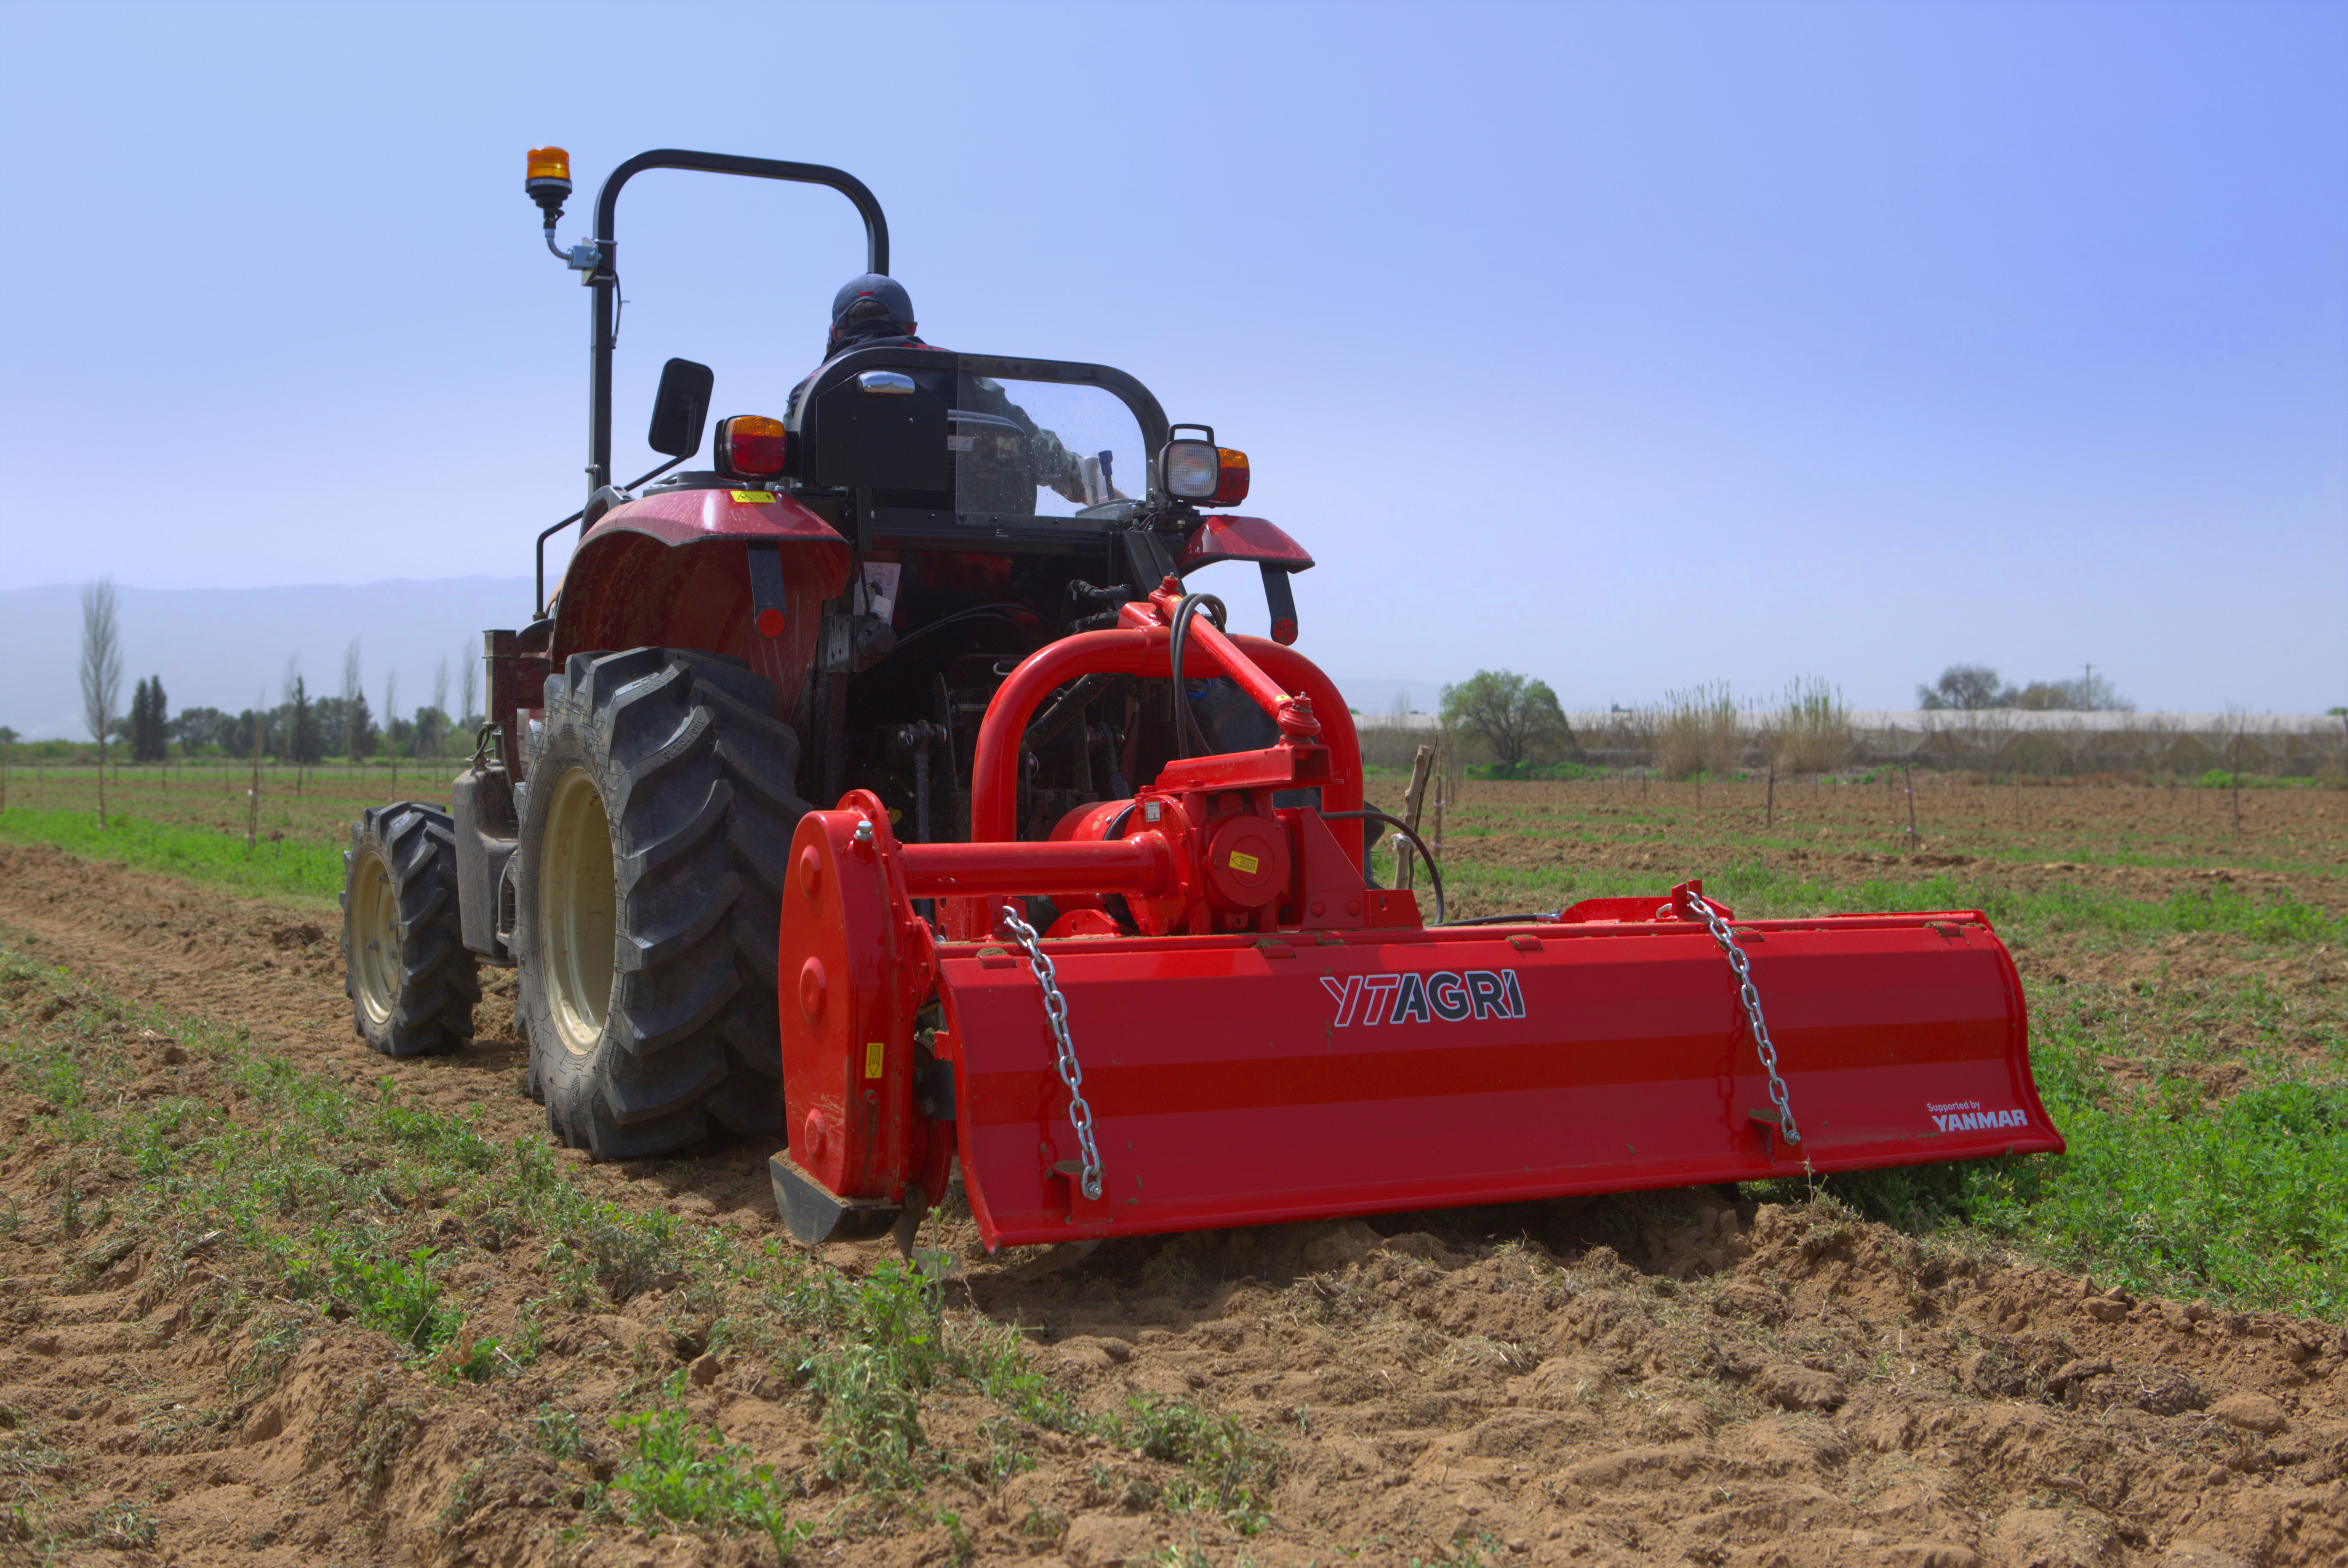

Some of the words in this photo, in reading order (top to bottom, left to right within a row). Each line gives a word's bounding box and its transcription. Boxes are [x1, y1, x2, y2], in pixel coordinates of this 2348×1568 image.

[662, 718, 705, 759] 360/70R20
[1320, 969, 1526, 1027] YTAGRI
[1927, 1101, 1969, 1113] Supported
[1969, 1101, 1980, 1110] by
[1931, 1109, 2028, 1132] YANMAR
